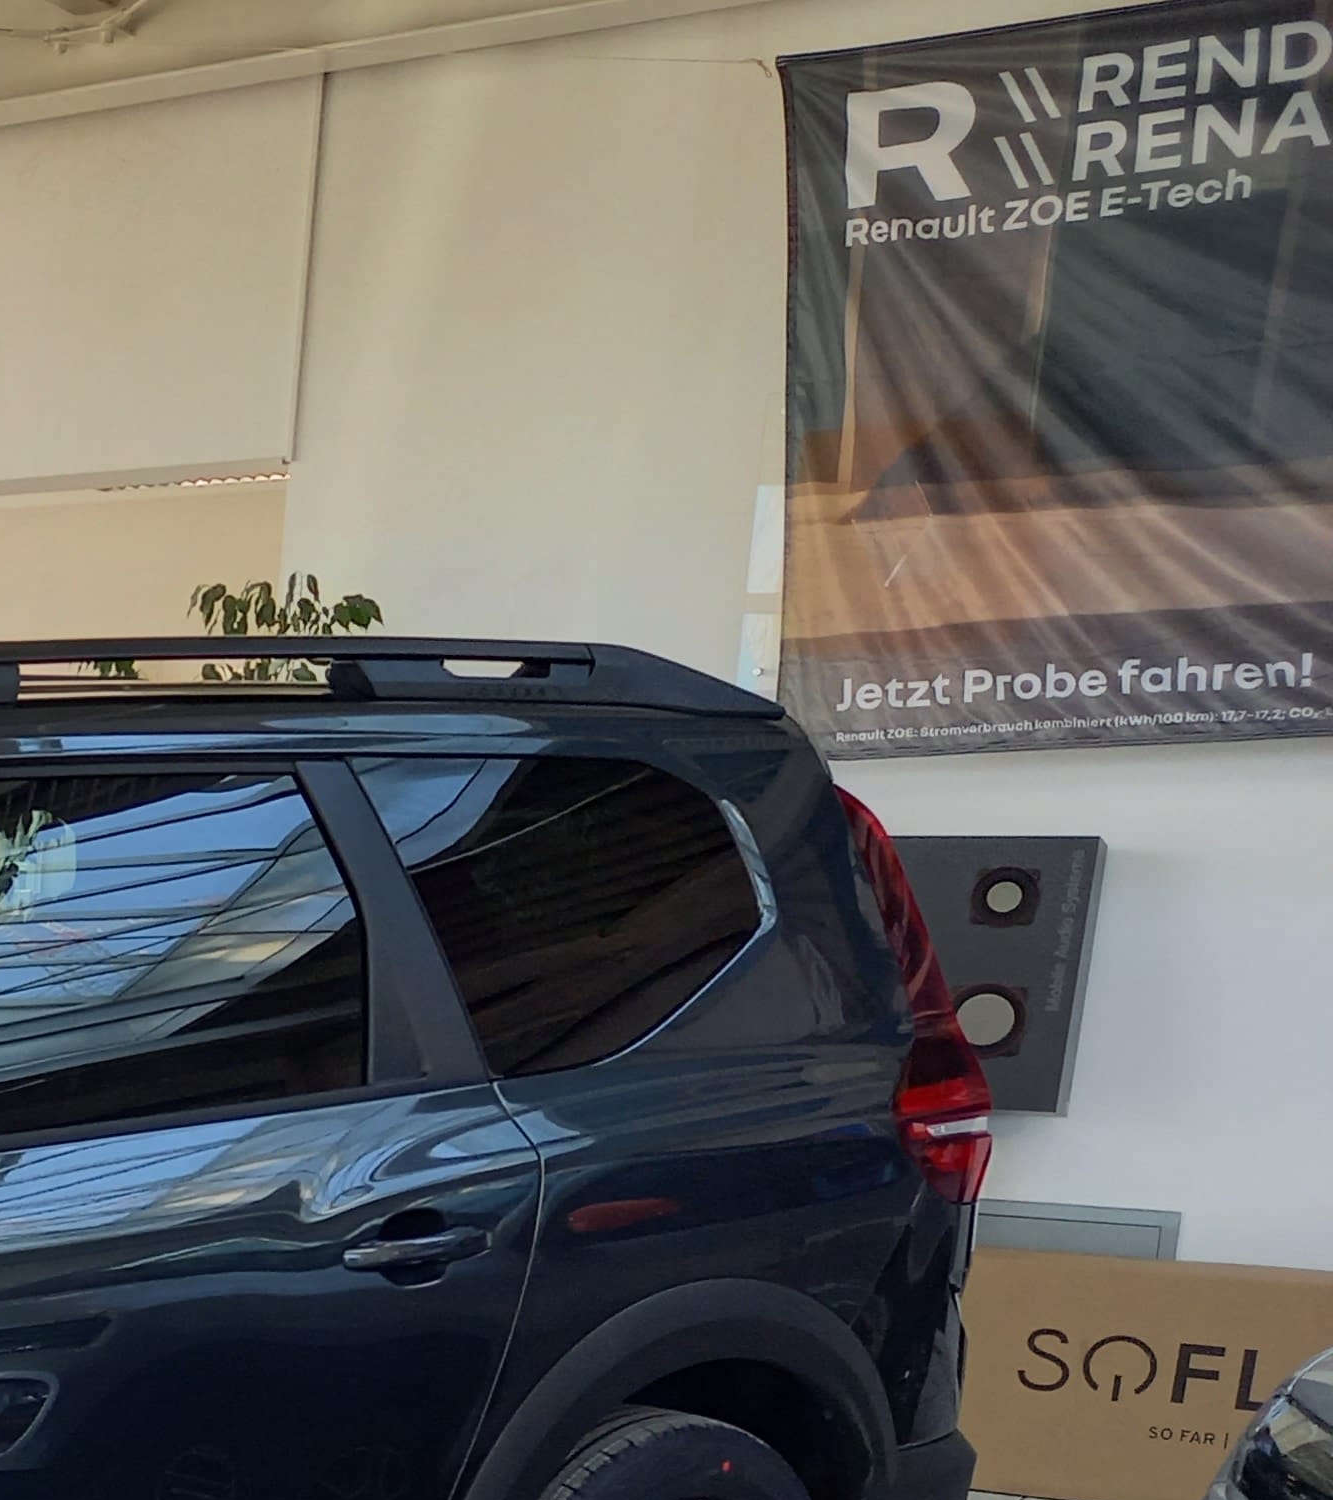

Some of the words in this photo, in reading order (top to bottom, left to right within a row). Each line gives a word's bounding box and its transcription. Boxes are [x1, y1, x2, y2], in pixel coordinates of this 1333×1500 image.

[1077, 20, 1333, 114] REND
[1071, 90, 1332, 182] RENA
[845, 204, 995, 247] Renault
[1002, 191, 1089, 231] ZOE
[1100, 168, 1253, 217] E-Tech
[836, 672, 951, 712] Jetzt
[962, 662, 1108, 704] Probe
[1118, 652, 1314, 695] fahren!
[835, 730, 884, 743] Renault
[885, 727, 918, 740] ZOE:
[919, 718, 1033, 738] Stromverbrauch
[1034, 715, 1112, 731] kombiniert
[1114, 711, 1183, 728] (kWh/100
[1185, 711, 1219, 723] km):
[1148, 1426, 1173, 1441] SO
[1180, 1429, 1215, 1446] FAR
